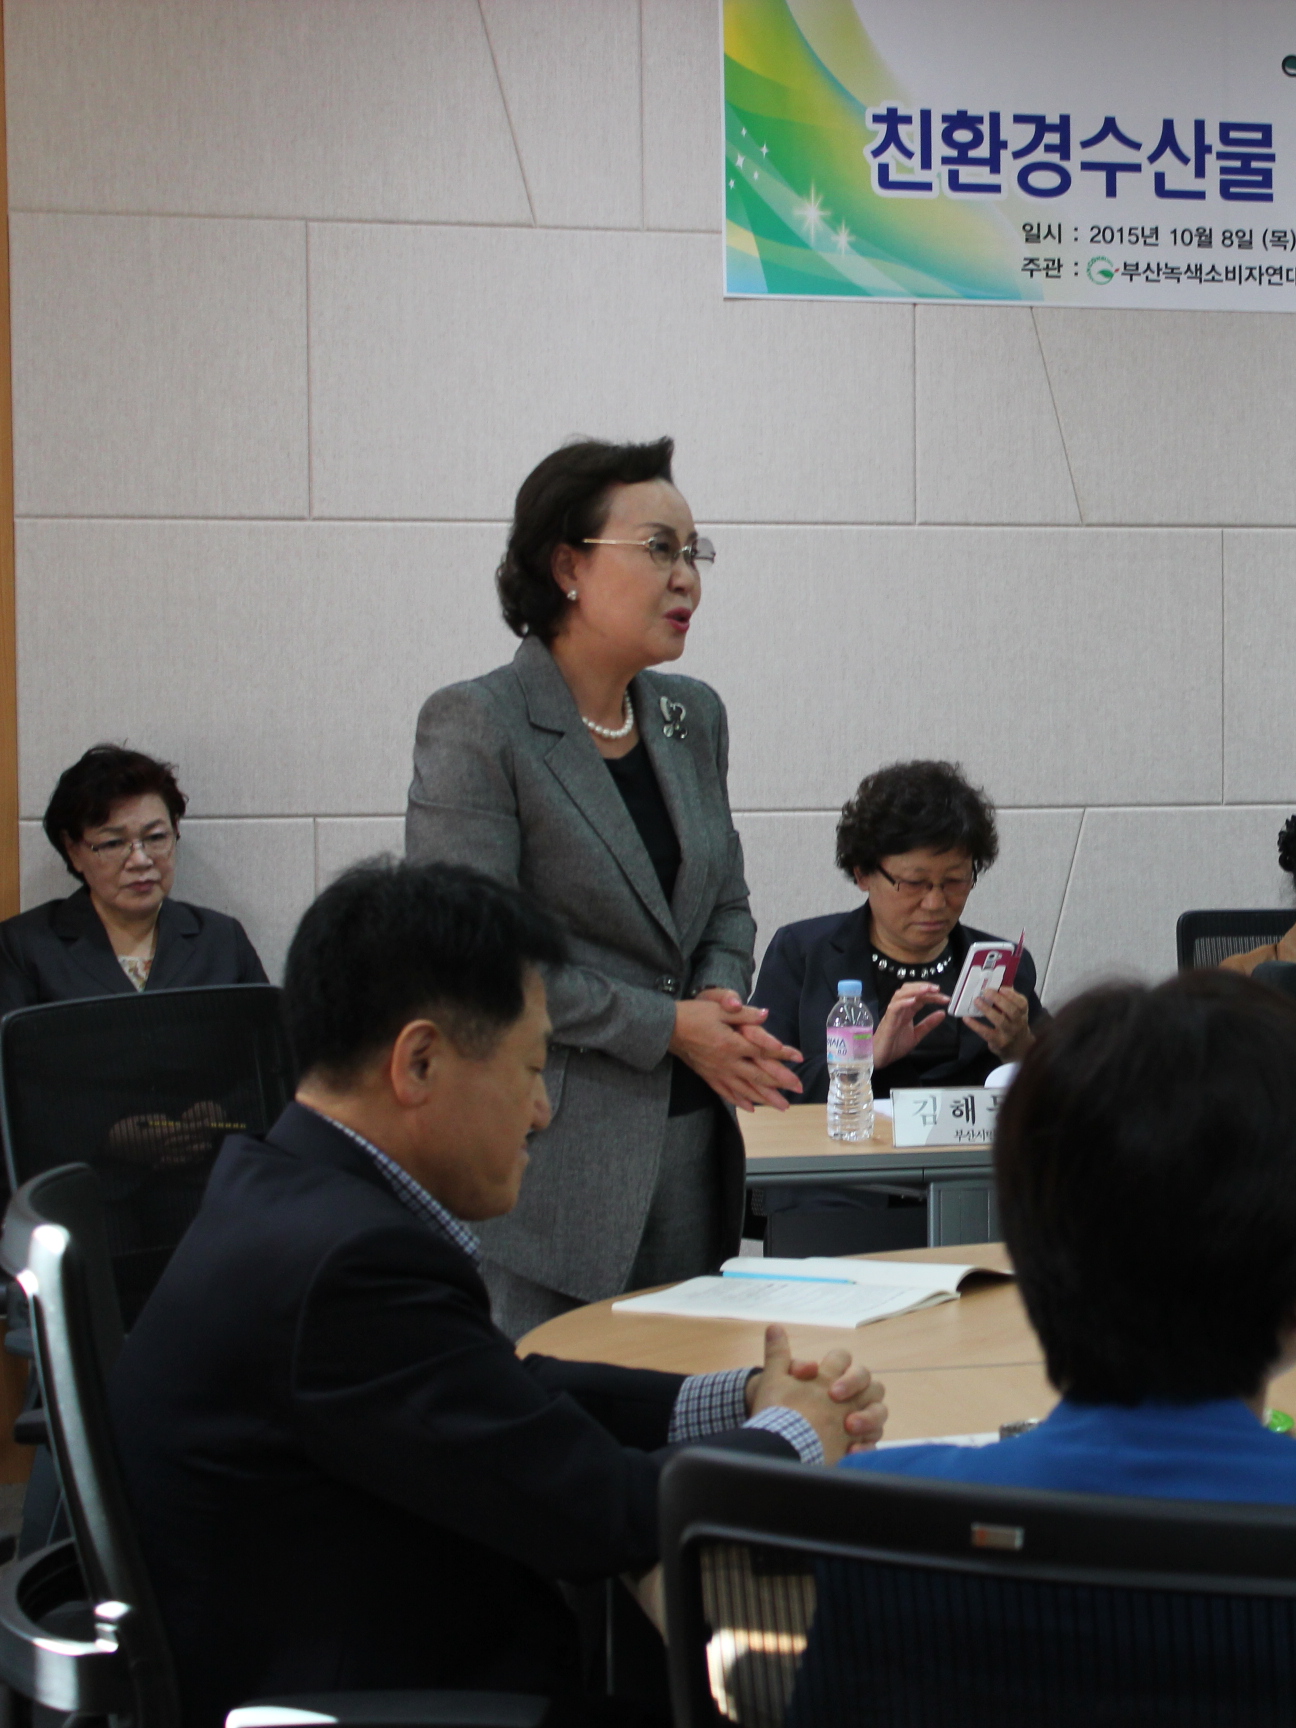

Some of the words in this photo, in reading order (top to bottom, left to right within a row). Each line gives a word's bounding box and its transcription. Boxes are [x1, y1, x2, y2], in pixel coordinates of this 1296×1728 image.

[869, 107, 1275, 203] 친환경수산물
[1089, 224, 1160, 248] 2015년
[1169, 225, 1214, 250] 10월
